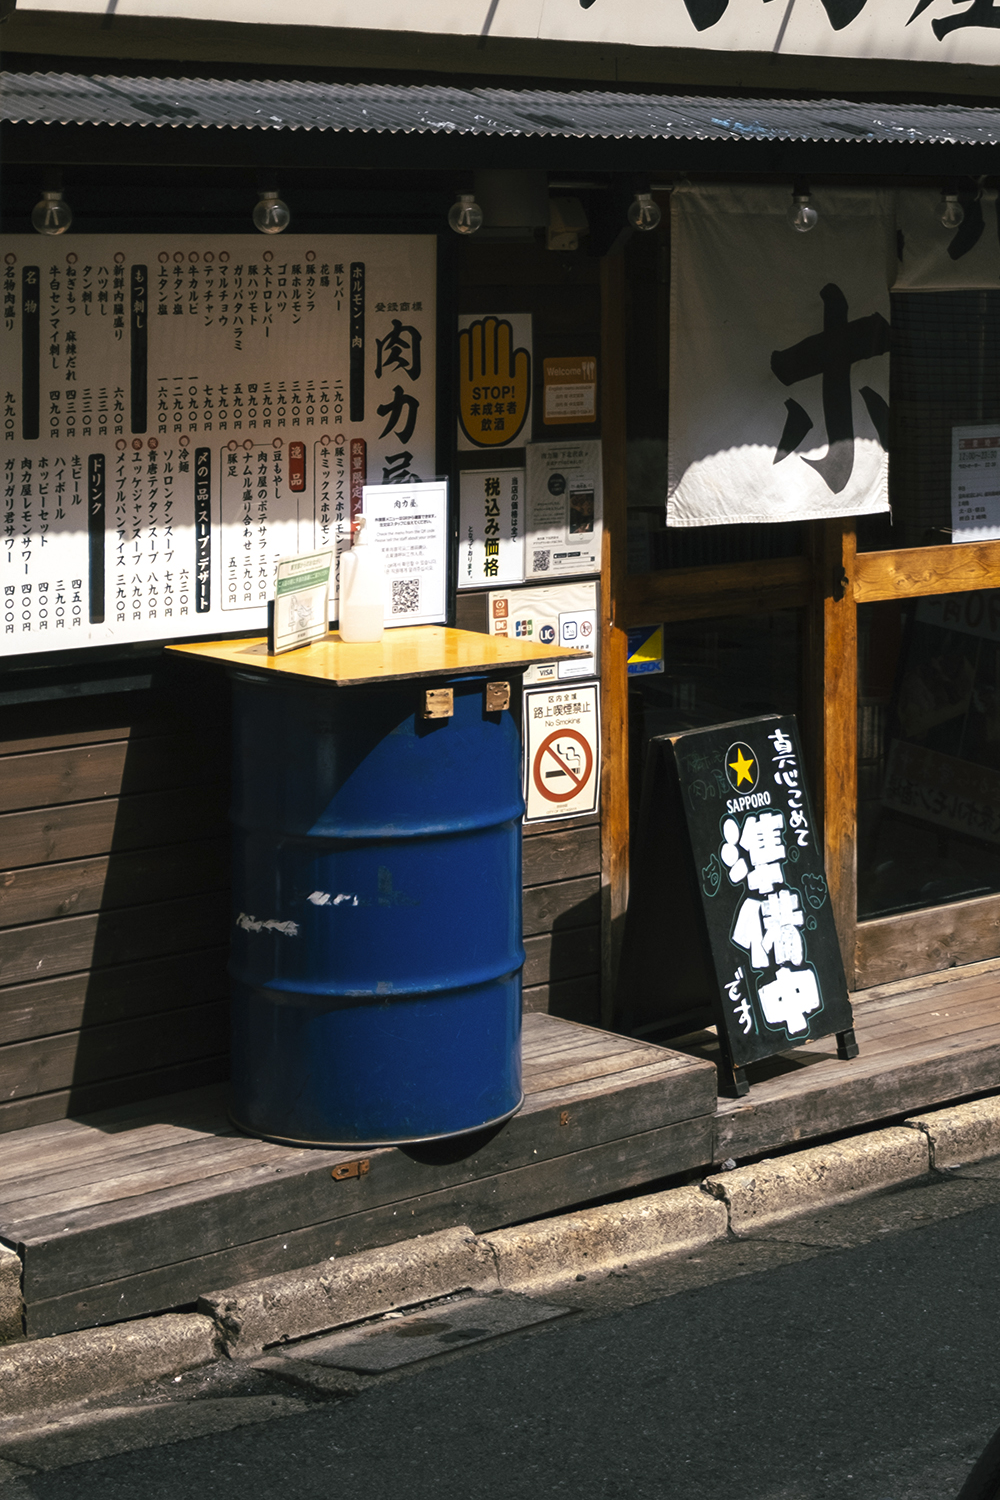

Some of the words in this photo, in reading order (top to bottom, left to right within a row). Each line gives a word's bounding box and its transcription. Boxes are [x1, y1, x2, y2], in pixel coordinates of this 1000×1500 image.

[25, 270, 37, 314] 名物
[133, 269, 145, 329] もつ刺し
[352, 266, 362, 349] ホルモン・肉
[546, 366, 582, 377] Welcome
[472, 385, 515, 401] STOP!
[470, 401, 517, 417] 未成年者
[481, 417, 505, 432] 飲酒
[91, 458, 103, 516] ドリンク
[484, 477, 501, 577] 税込み価格
[540, 629, 555, 641] UC
[539, 668, 554, 677] VISA
[533, 702, 592, 719] 路上喫煙禁止
[555, 718, 581, 726] Smoking
[767, 728, 812, 847] 真心こめて
[726, 790, 771, 814] SAPPORO
[719, 810, 822, 1036] 準備中
[724, 966, 752, 1035] です
